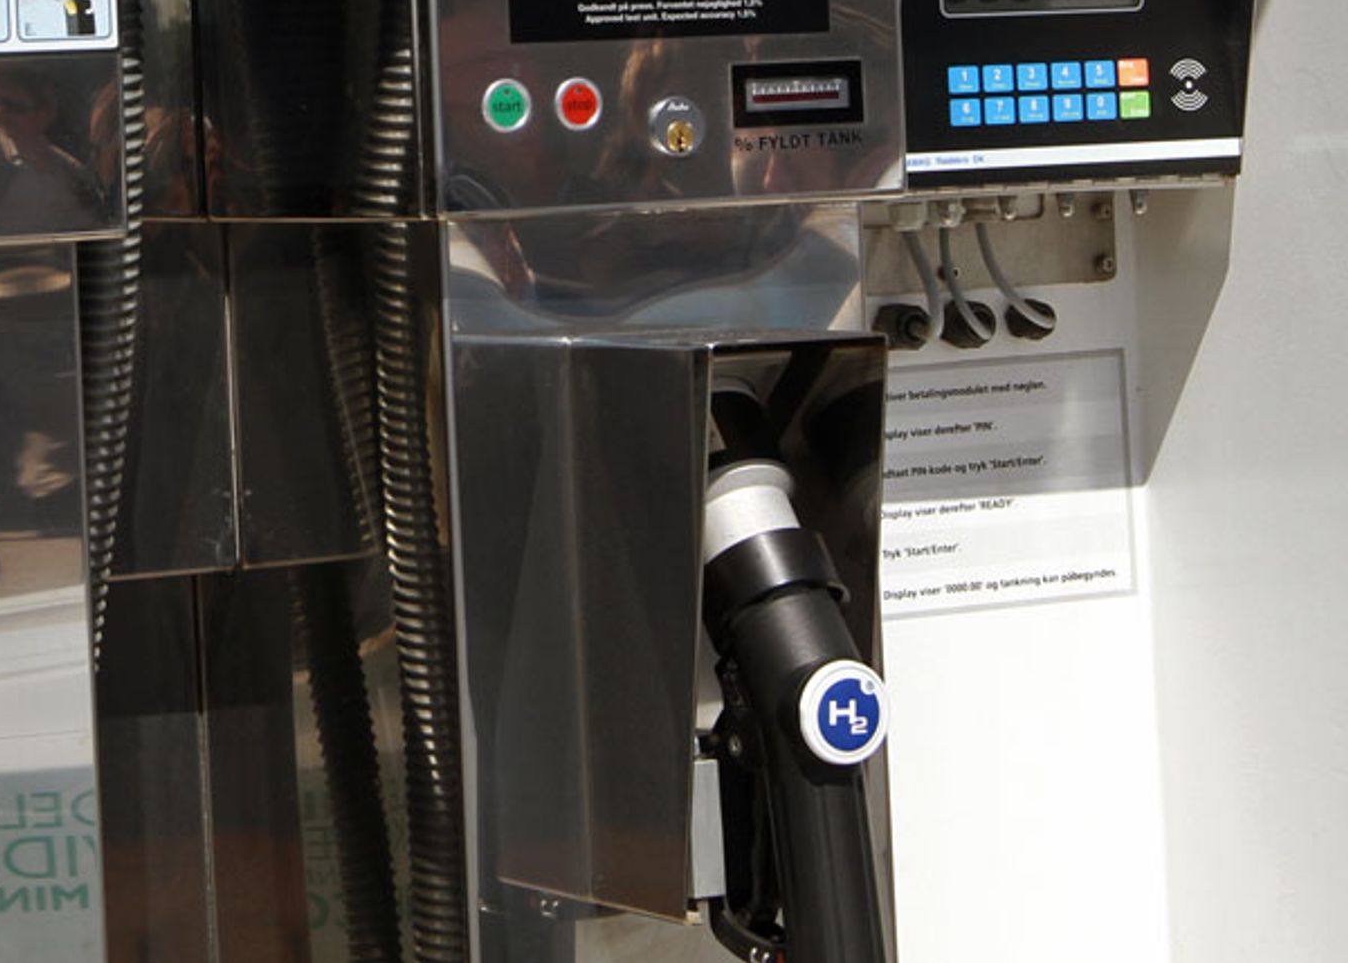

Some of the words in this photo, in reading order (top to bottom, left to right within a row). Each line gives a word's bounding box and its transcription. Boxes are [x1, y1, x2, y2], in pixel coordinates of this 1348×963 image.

[492, 101, 522, 113] start
[759, 134, 810, 150] FYLDT
[819, 130, 862, 146] TANK
[934, 422, 972, 436] derefter
[955, 464, 967, 474] og
[968, 461, 987, 473] tryk
[939, 502, 976, 515] derefter
[883, 549, 901, 560] Tryk
[883, 588, 917, 601] Display
[919, 586, 941, 597] viser
